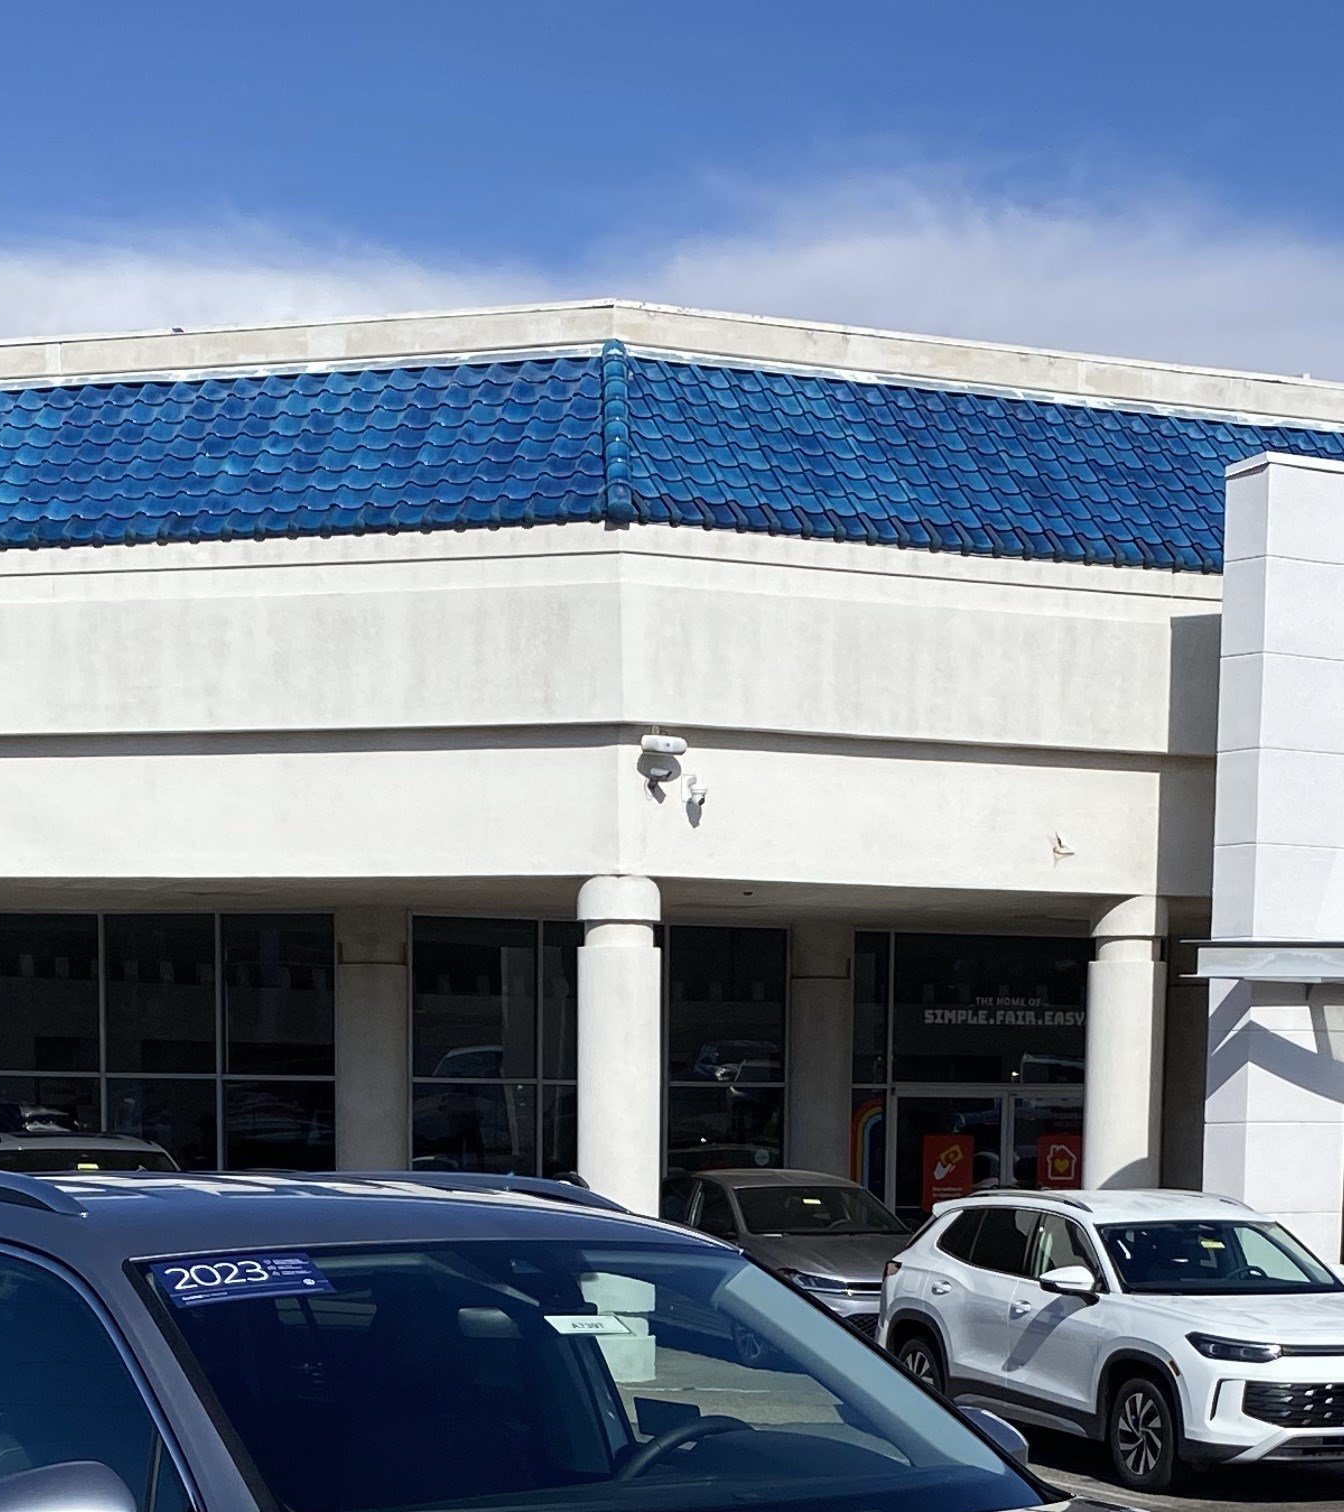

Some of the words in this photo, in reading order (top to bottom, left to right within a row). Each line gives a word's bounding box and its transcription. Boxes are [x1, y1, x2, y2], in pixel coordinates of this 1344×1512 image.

[975, 997, 994, 1006] THE
[996, 997, 1025, 1006] HOME
[164, 1260, 269, 1290] 2023
